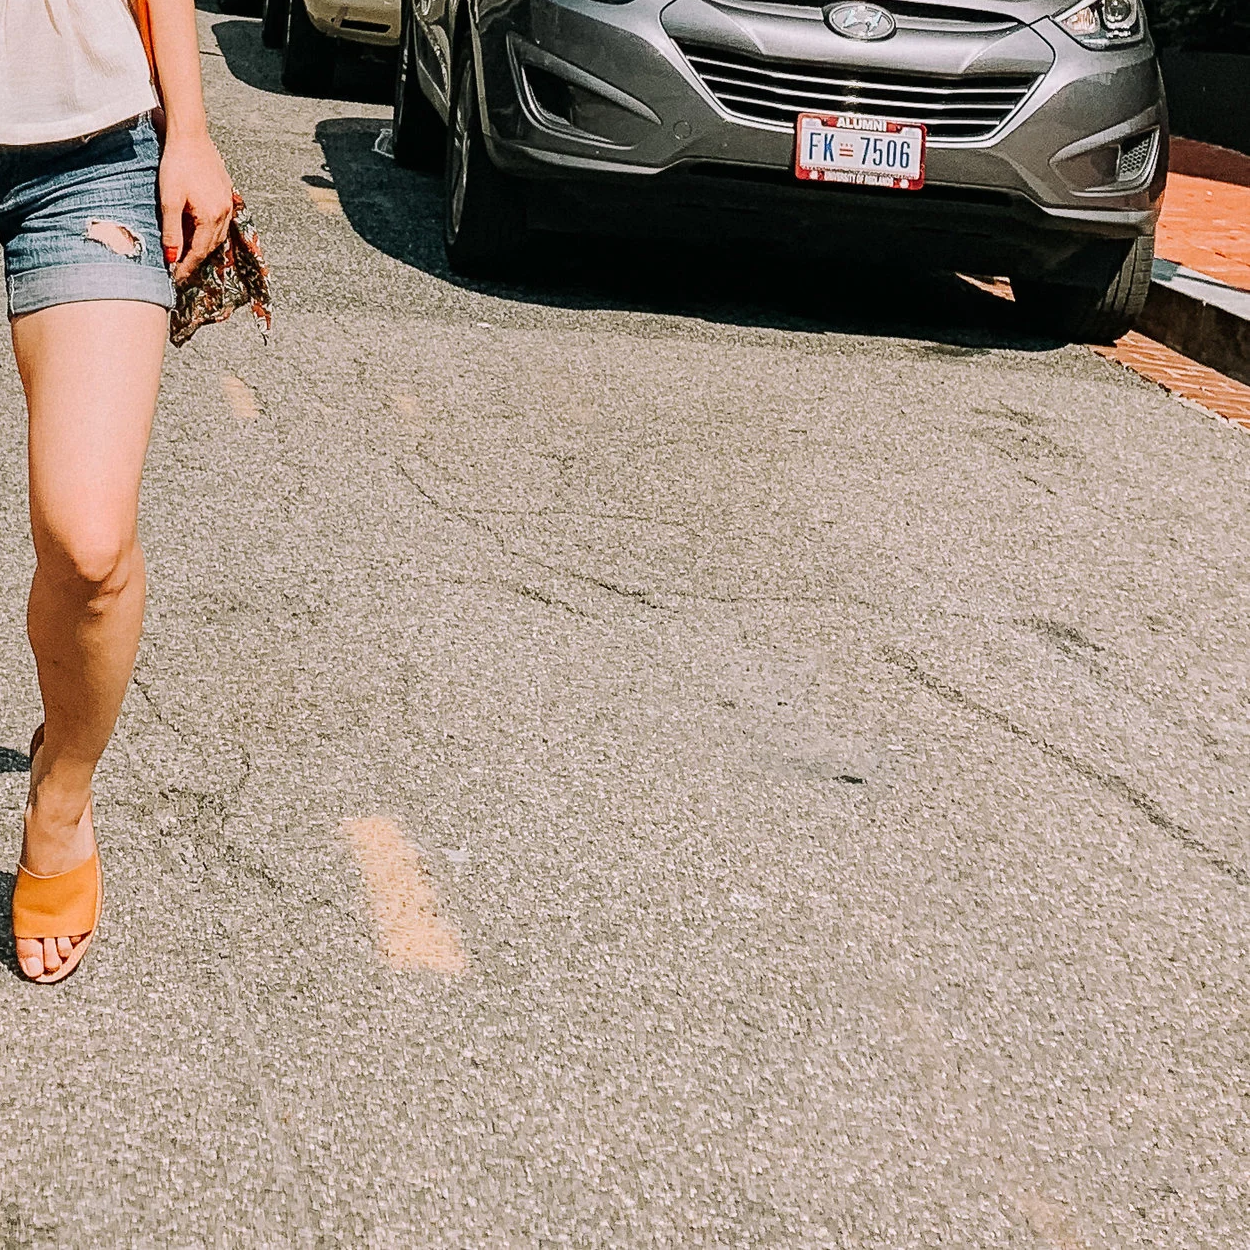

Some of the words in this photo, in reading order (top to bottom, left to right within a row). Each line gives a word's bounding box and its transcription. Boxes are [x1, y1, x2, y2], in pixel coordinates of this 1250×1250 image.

[836, 116, 888, 132] ALUMNI
[808, 132, 835, 162] FK
[860, 136, 911, 169] 7506
